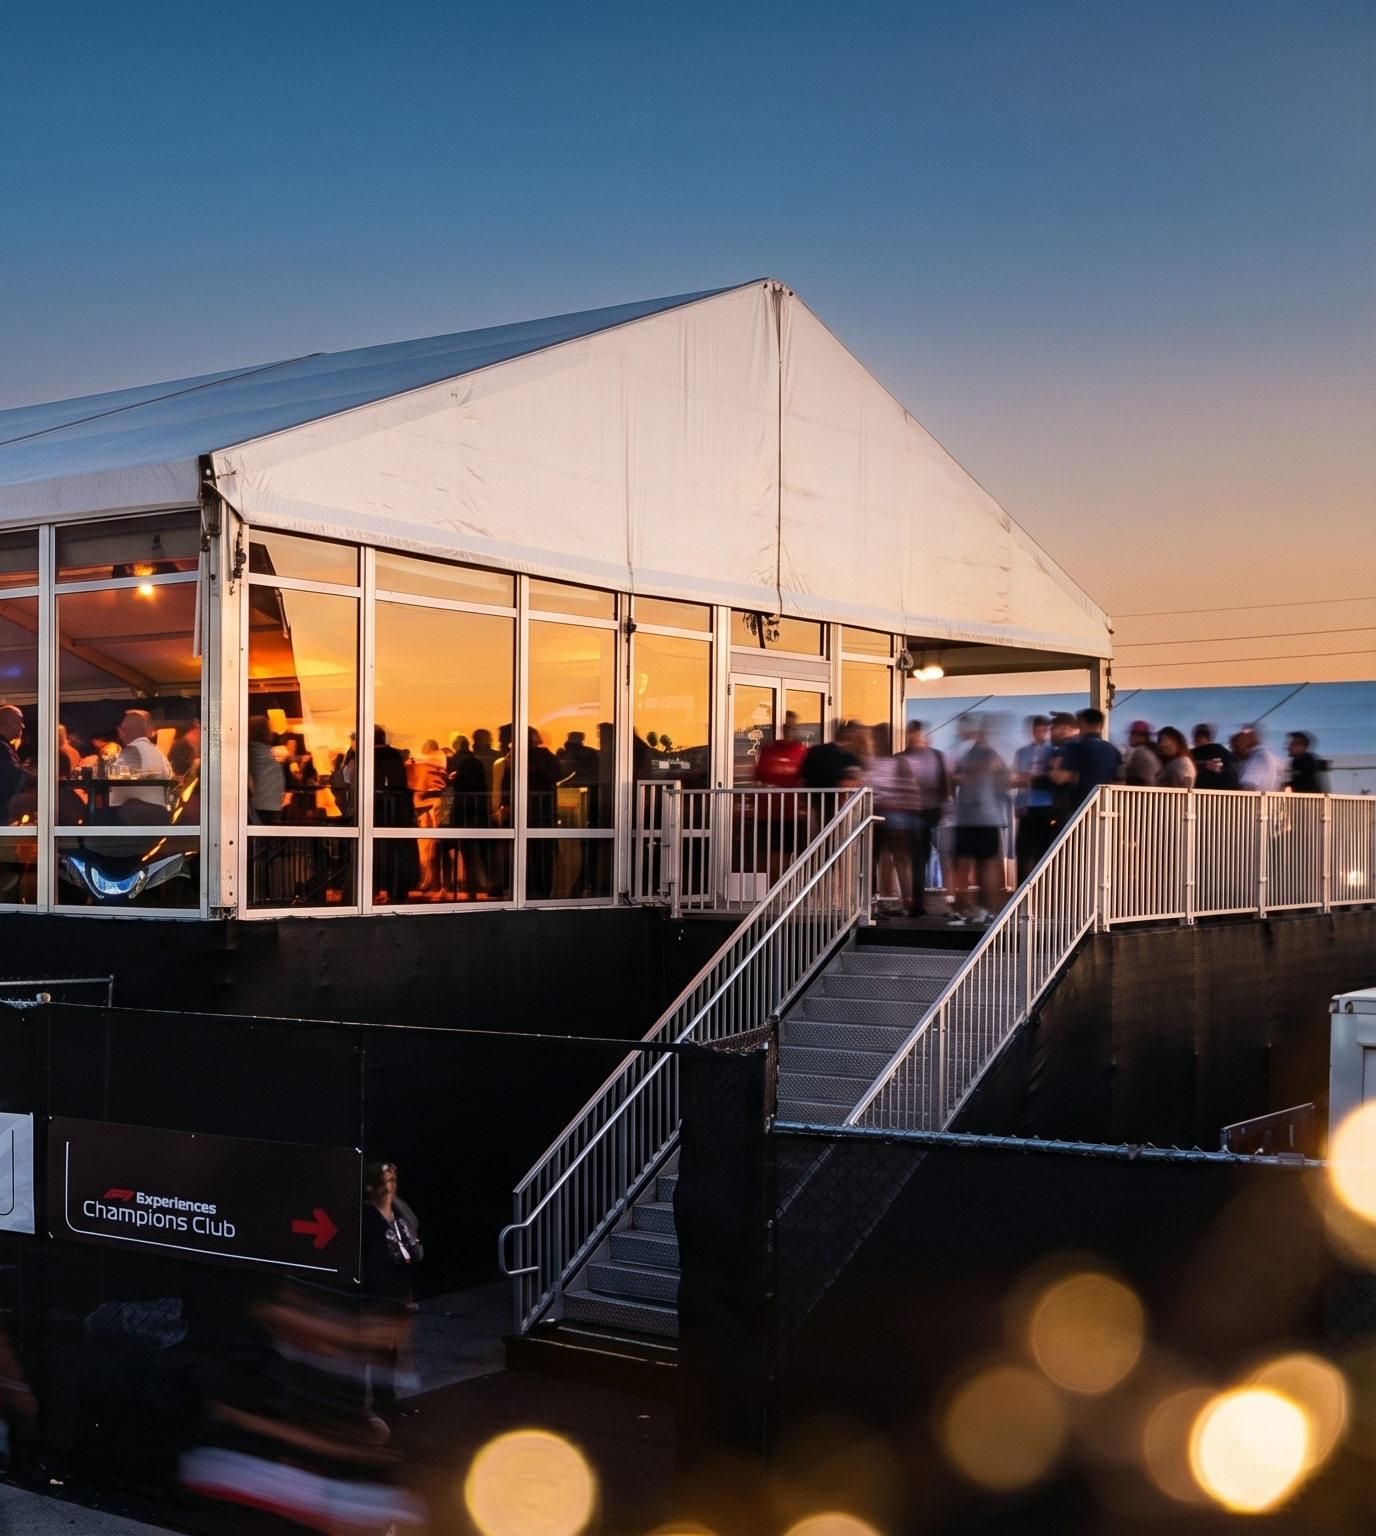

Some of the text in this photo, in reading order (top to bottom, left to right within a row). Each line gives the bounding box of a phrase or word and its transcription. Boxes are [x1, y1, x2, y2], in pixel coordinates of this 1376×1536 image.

[136, 1191, 217, 1215] Experiences
[83, 1200, 236, 1238] Champions Club
